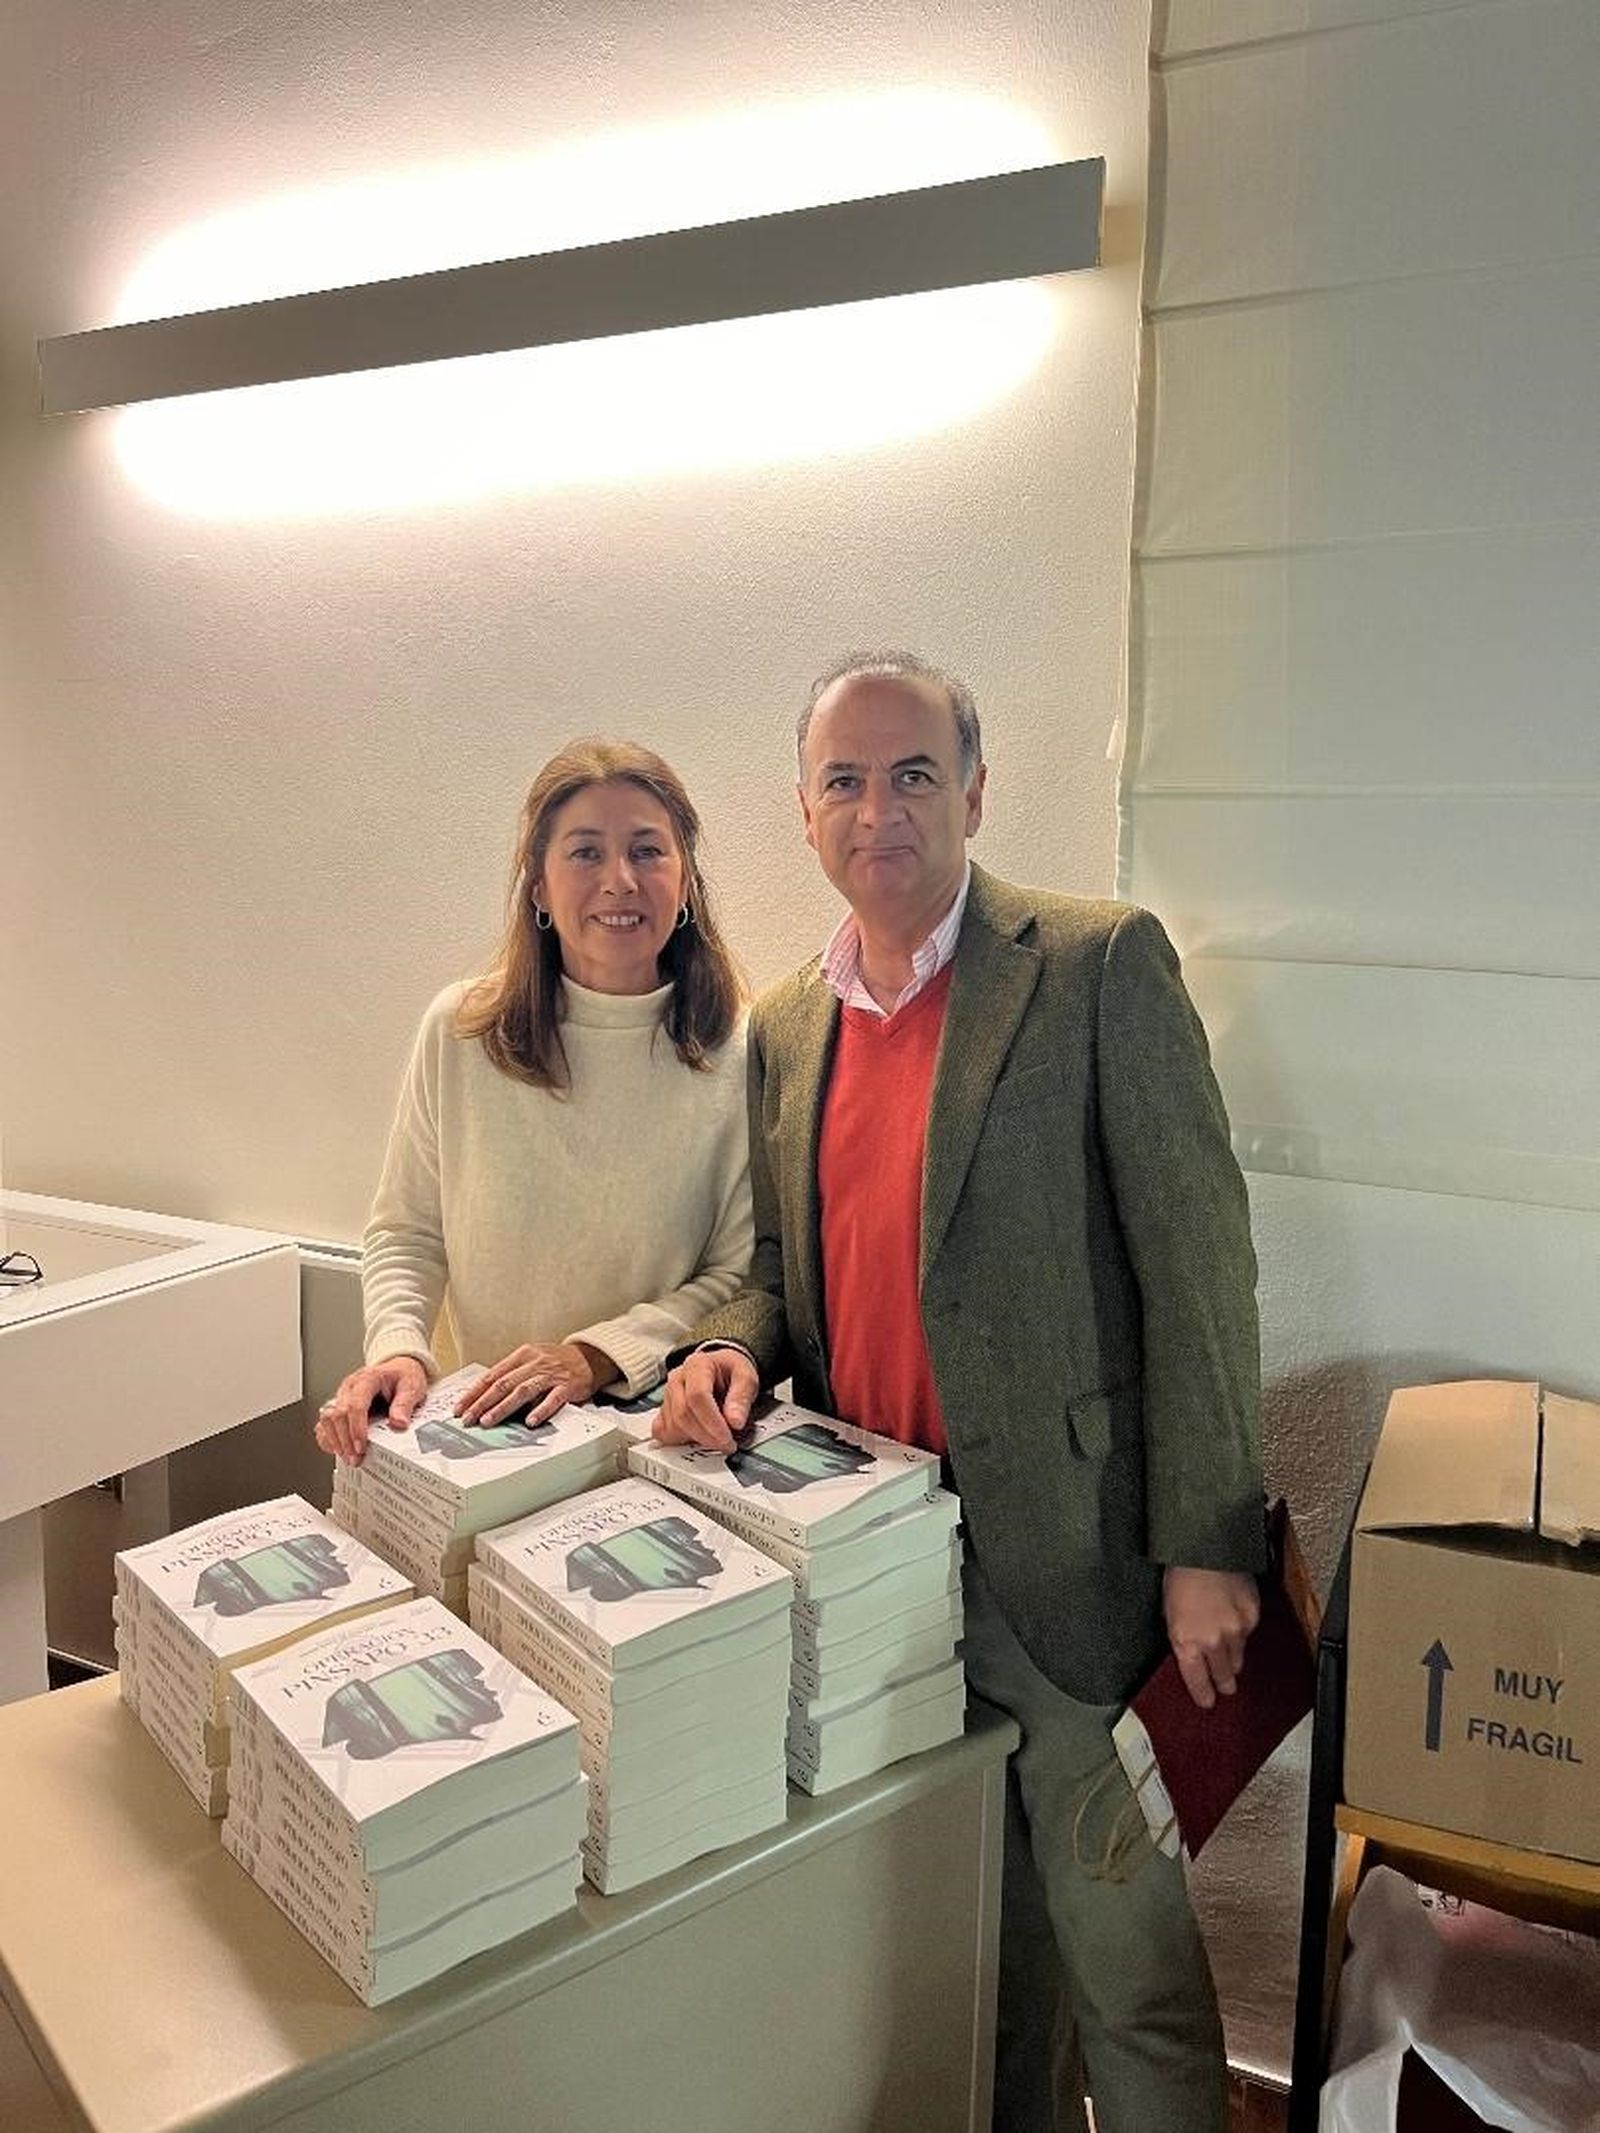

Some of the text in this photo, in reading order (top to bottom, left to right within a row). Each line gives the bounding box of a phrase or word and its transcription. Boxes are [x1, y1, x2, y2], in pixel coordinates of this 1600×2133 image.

[281, 1641, 407, 1699] PINSAPO
[1494, 1667, 1565, 1704] MUY
[1466, 1717, 1583, 1764] FRAGIL
